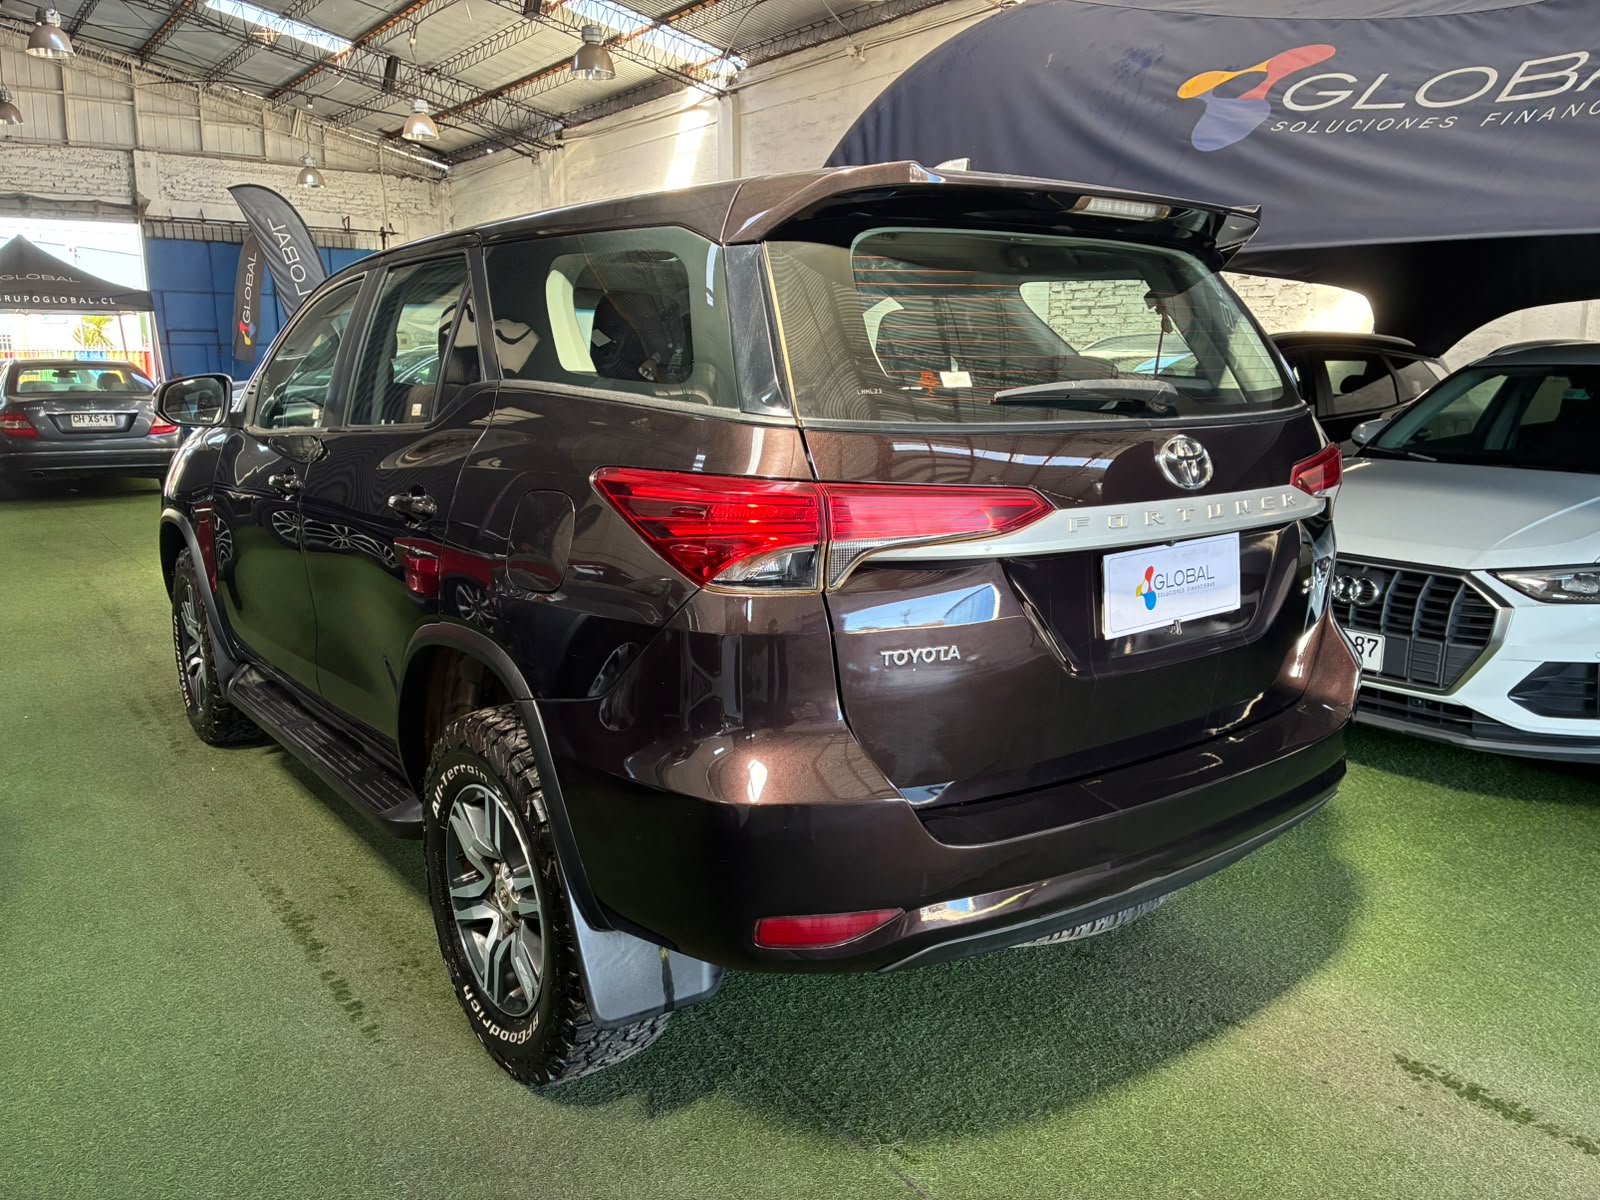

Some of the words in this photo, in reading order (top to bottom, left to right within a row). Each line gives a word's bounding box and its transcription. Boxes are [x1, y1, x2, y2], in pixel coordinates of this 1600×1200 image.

[1282, 51, 1600, 112] GLOB
[1270, 116, 1458, 134] SOLUCIONES
[0, 273, 81, 282] GLOBAL
[243, 252, 257, 323] GLOBAL
[0, 294, 116, 305] RUPOGLOBAL.CL
[1067, 492, 1298, 533] FORTUNER
[1153, 565, 1215, 590] GLOBAL
[880, 644, 961, 667] TOYOTA
[1354, 636, 1379, 658] 87
[463, 984, 539, 1045] BFGoodrich
